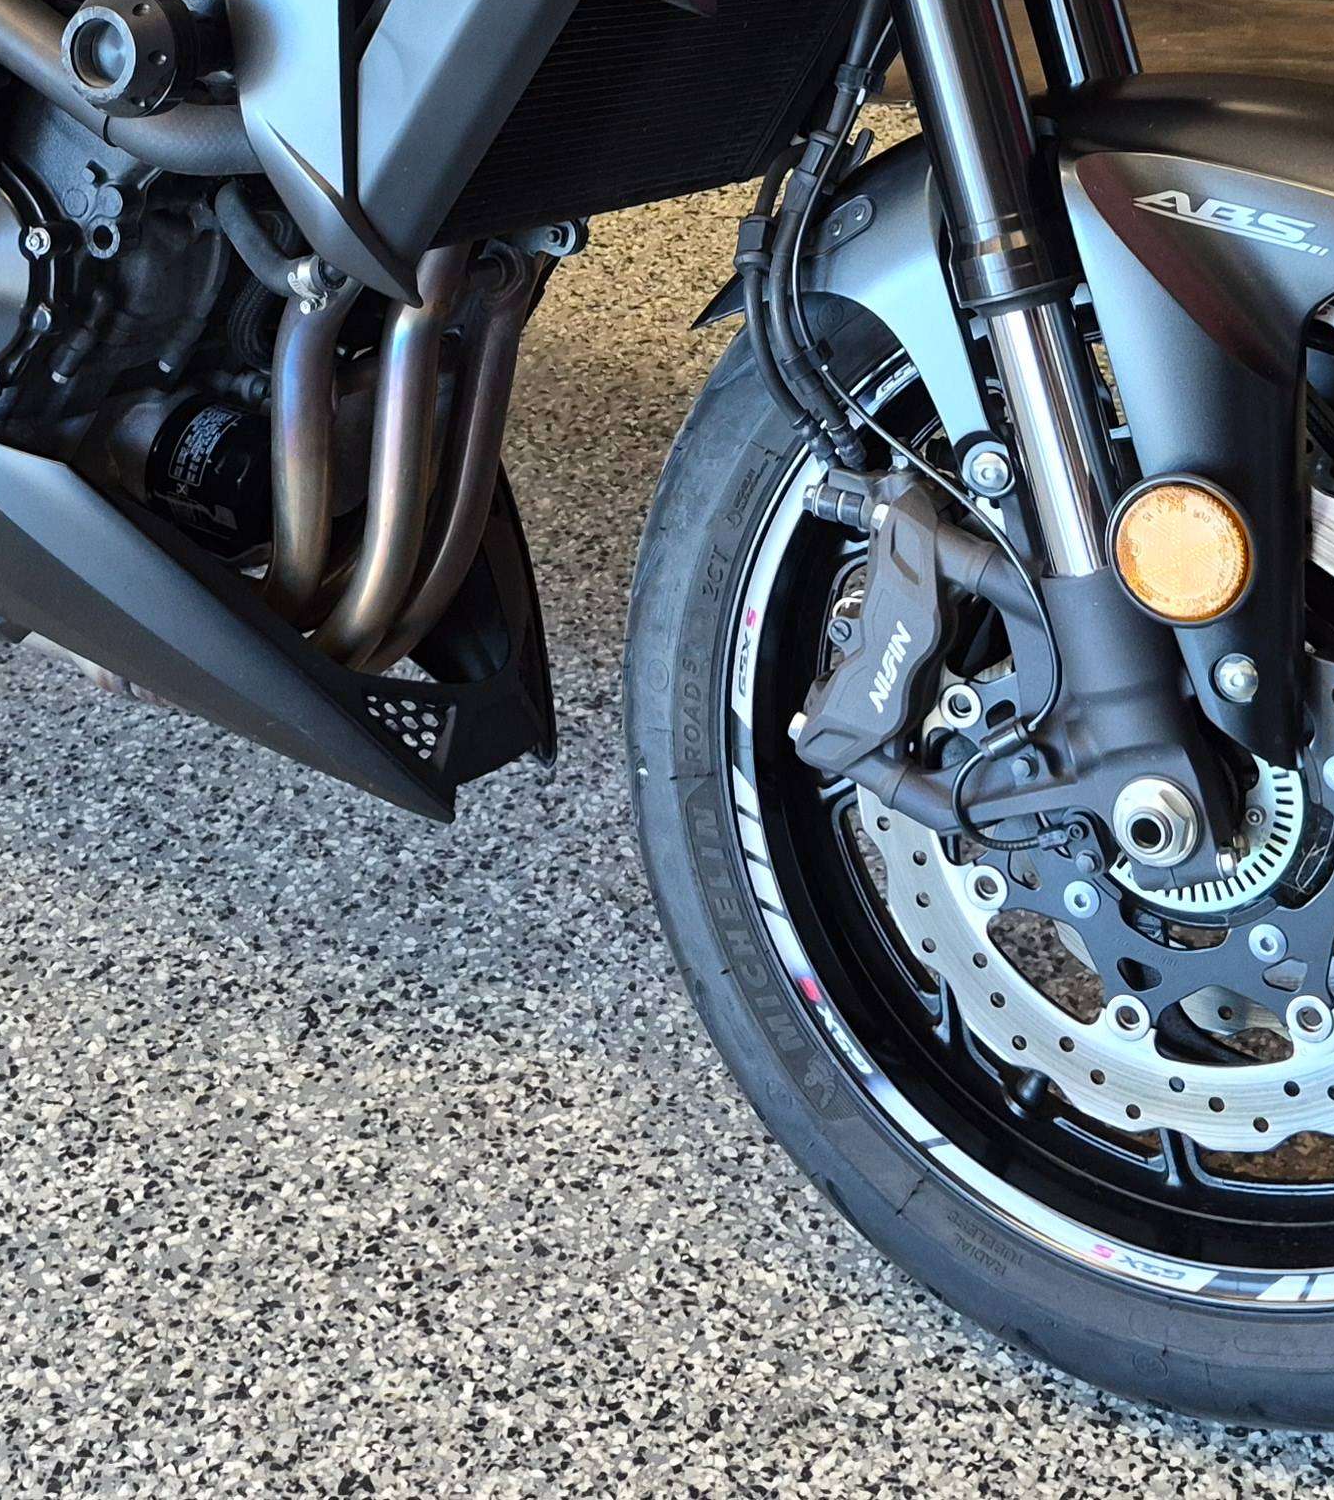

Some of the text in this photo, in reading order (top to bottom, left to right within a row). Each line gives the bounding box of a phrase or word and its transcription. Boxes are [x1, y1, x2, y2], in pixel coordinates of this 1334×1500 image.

[1132, 190, 1316, 243] ABS
[682, 681, 704, 766] ROAD
[692, 806, 808, 1049] MICHELIN
[953, 1232, 1008, 1278] RADIAL
